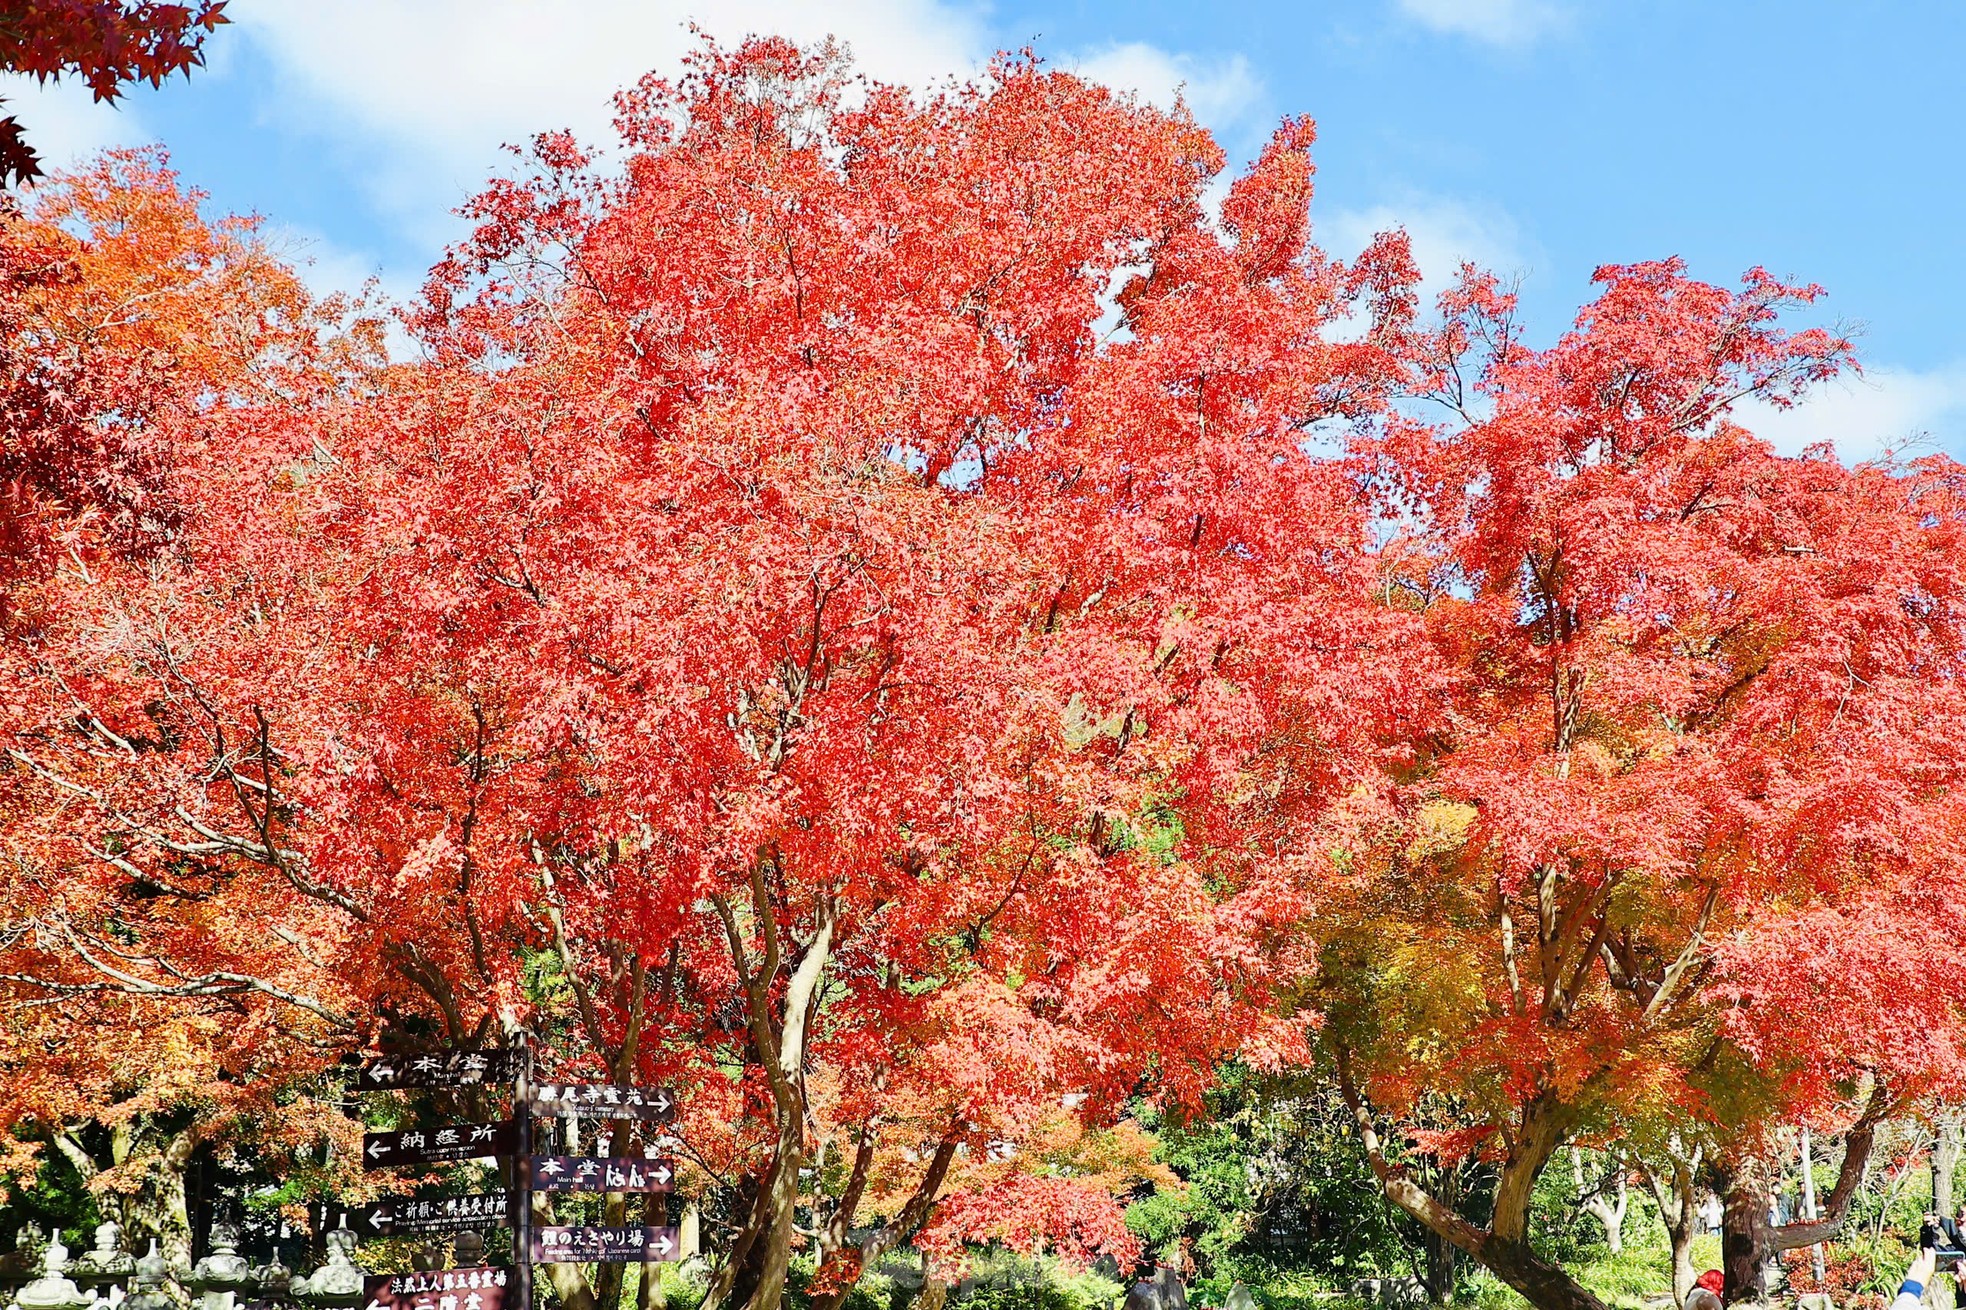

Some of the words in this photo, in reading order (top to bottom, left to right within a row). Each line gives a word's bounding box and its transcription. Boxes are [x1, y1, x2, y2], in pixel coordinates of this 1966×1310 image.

[412, 1053, 489, 1073] 本堂
[399, 1123, 497, 1150] 納経所
[539, 1157, 601, 1176] 本堂
[541, 1229, 645, 1247] 鯉のえさやり場
